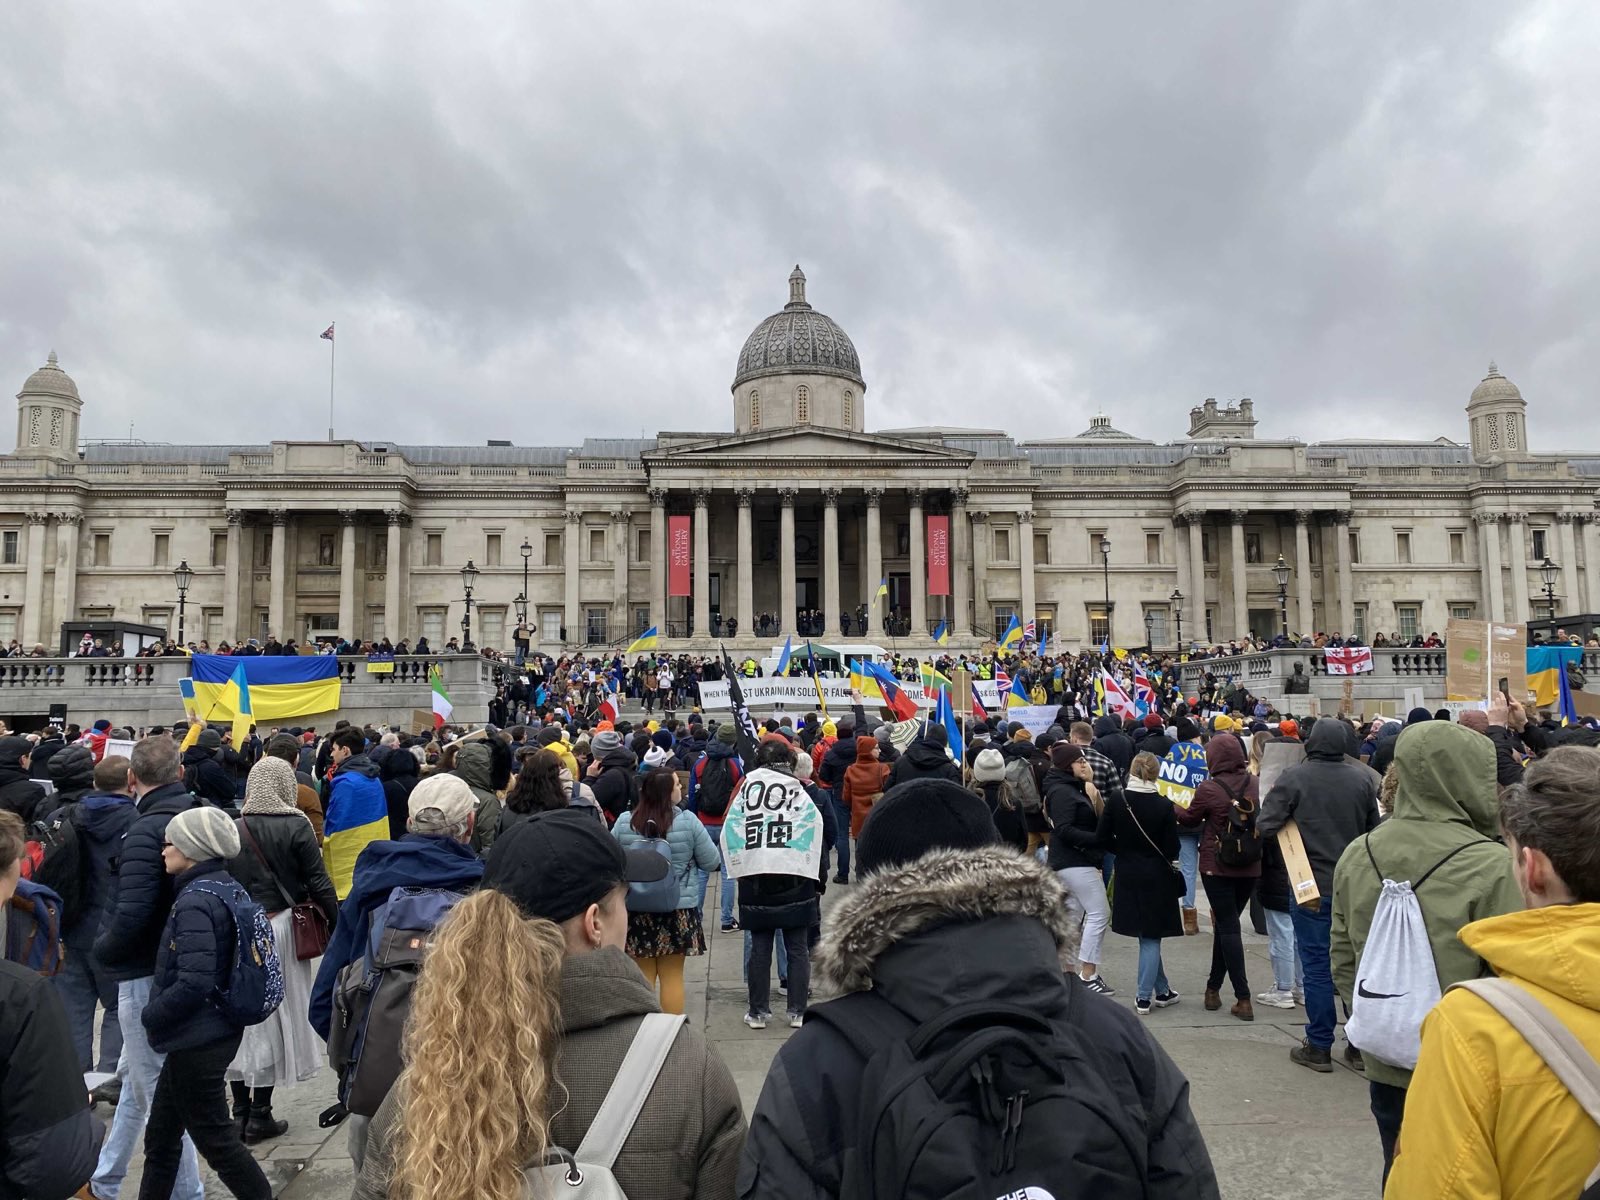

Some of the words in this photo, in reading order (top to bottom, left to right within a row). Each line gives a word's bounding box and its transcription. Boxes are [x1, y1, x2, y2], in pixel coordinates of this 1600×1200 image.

[704, 690, 720, 698] WHEN
[754, 686, 796, 697] UKRAINIAN
[1159, 761, 1188, 783] NO
[1167, 785, 1194, 804] WA
